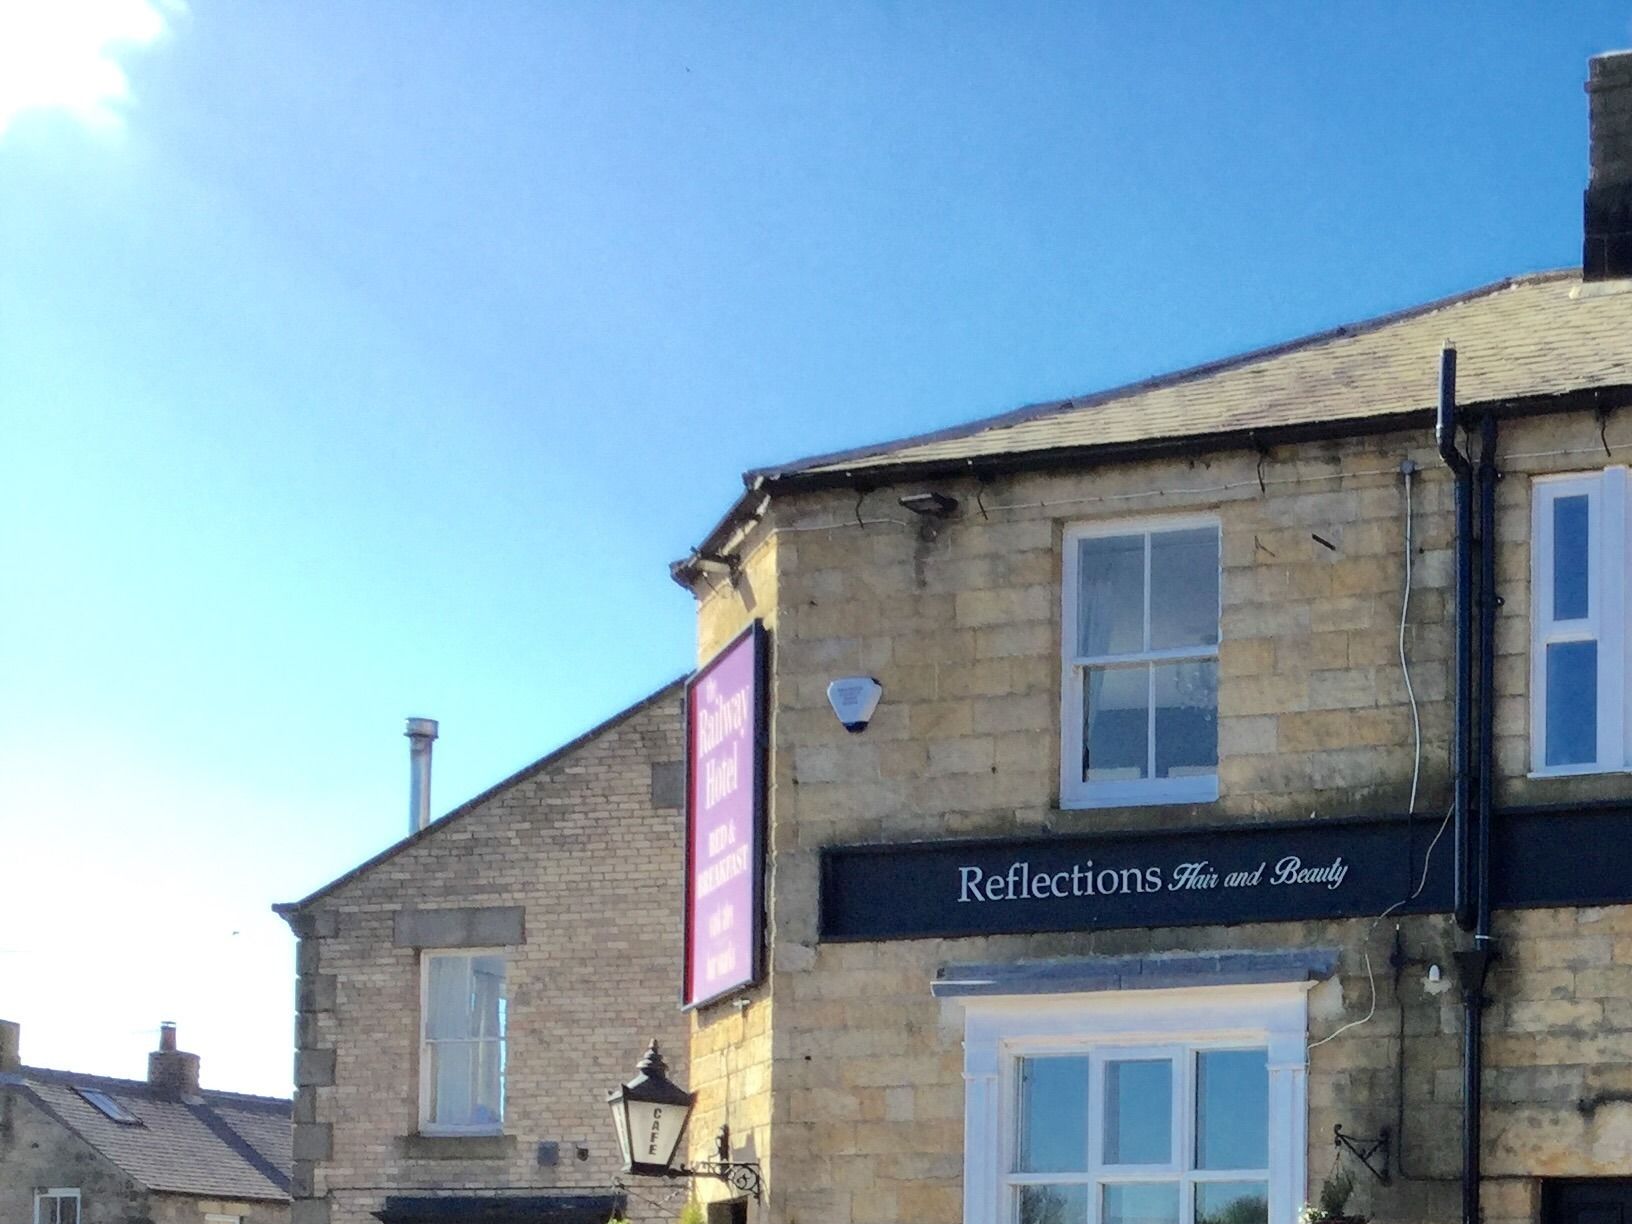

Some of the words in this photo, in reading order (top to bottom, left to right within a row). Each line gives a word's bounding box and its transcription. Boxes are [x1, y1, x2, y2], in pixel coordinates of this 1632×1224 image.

[699, 685, 750, 759] Railway
[706, 741, 738, 810] Hotel
[709, 824, 728, 858] BED
[697, 843, 749, 900] BREAKFAST
[957, 859, 1162, 902] Reflections
[1168, 861, 1219, 892] Hair
[1224, 862, 1266, 888] and
[1270, 855, 1349, 890] Beauty
[648, 1108, 662, 1155] CAFE
